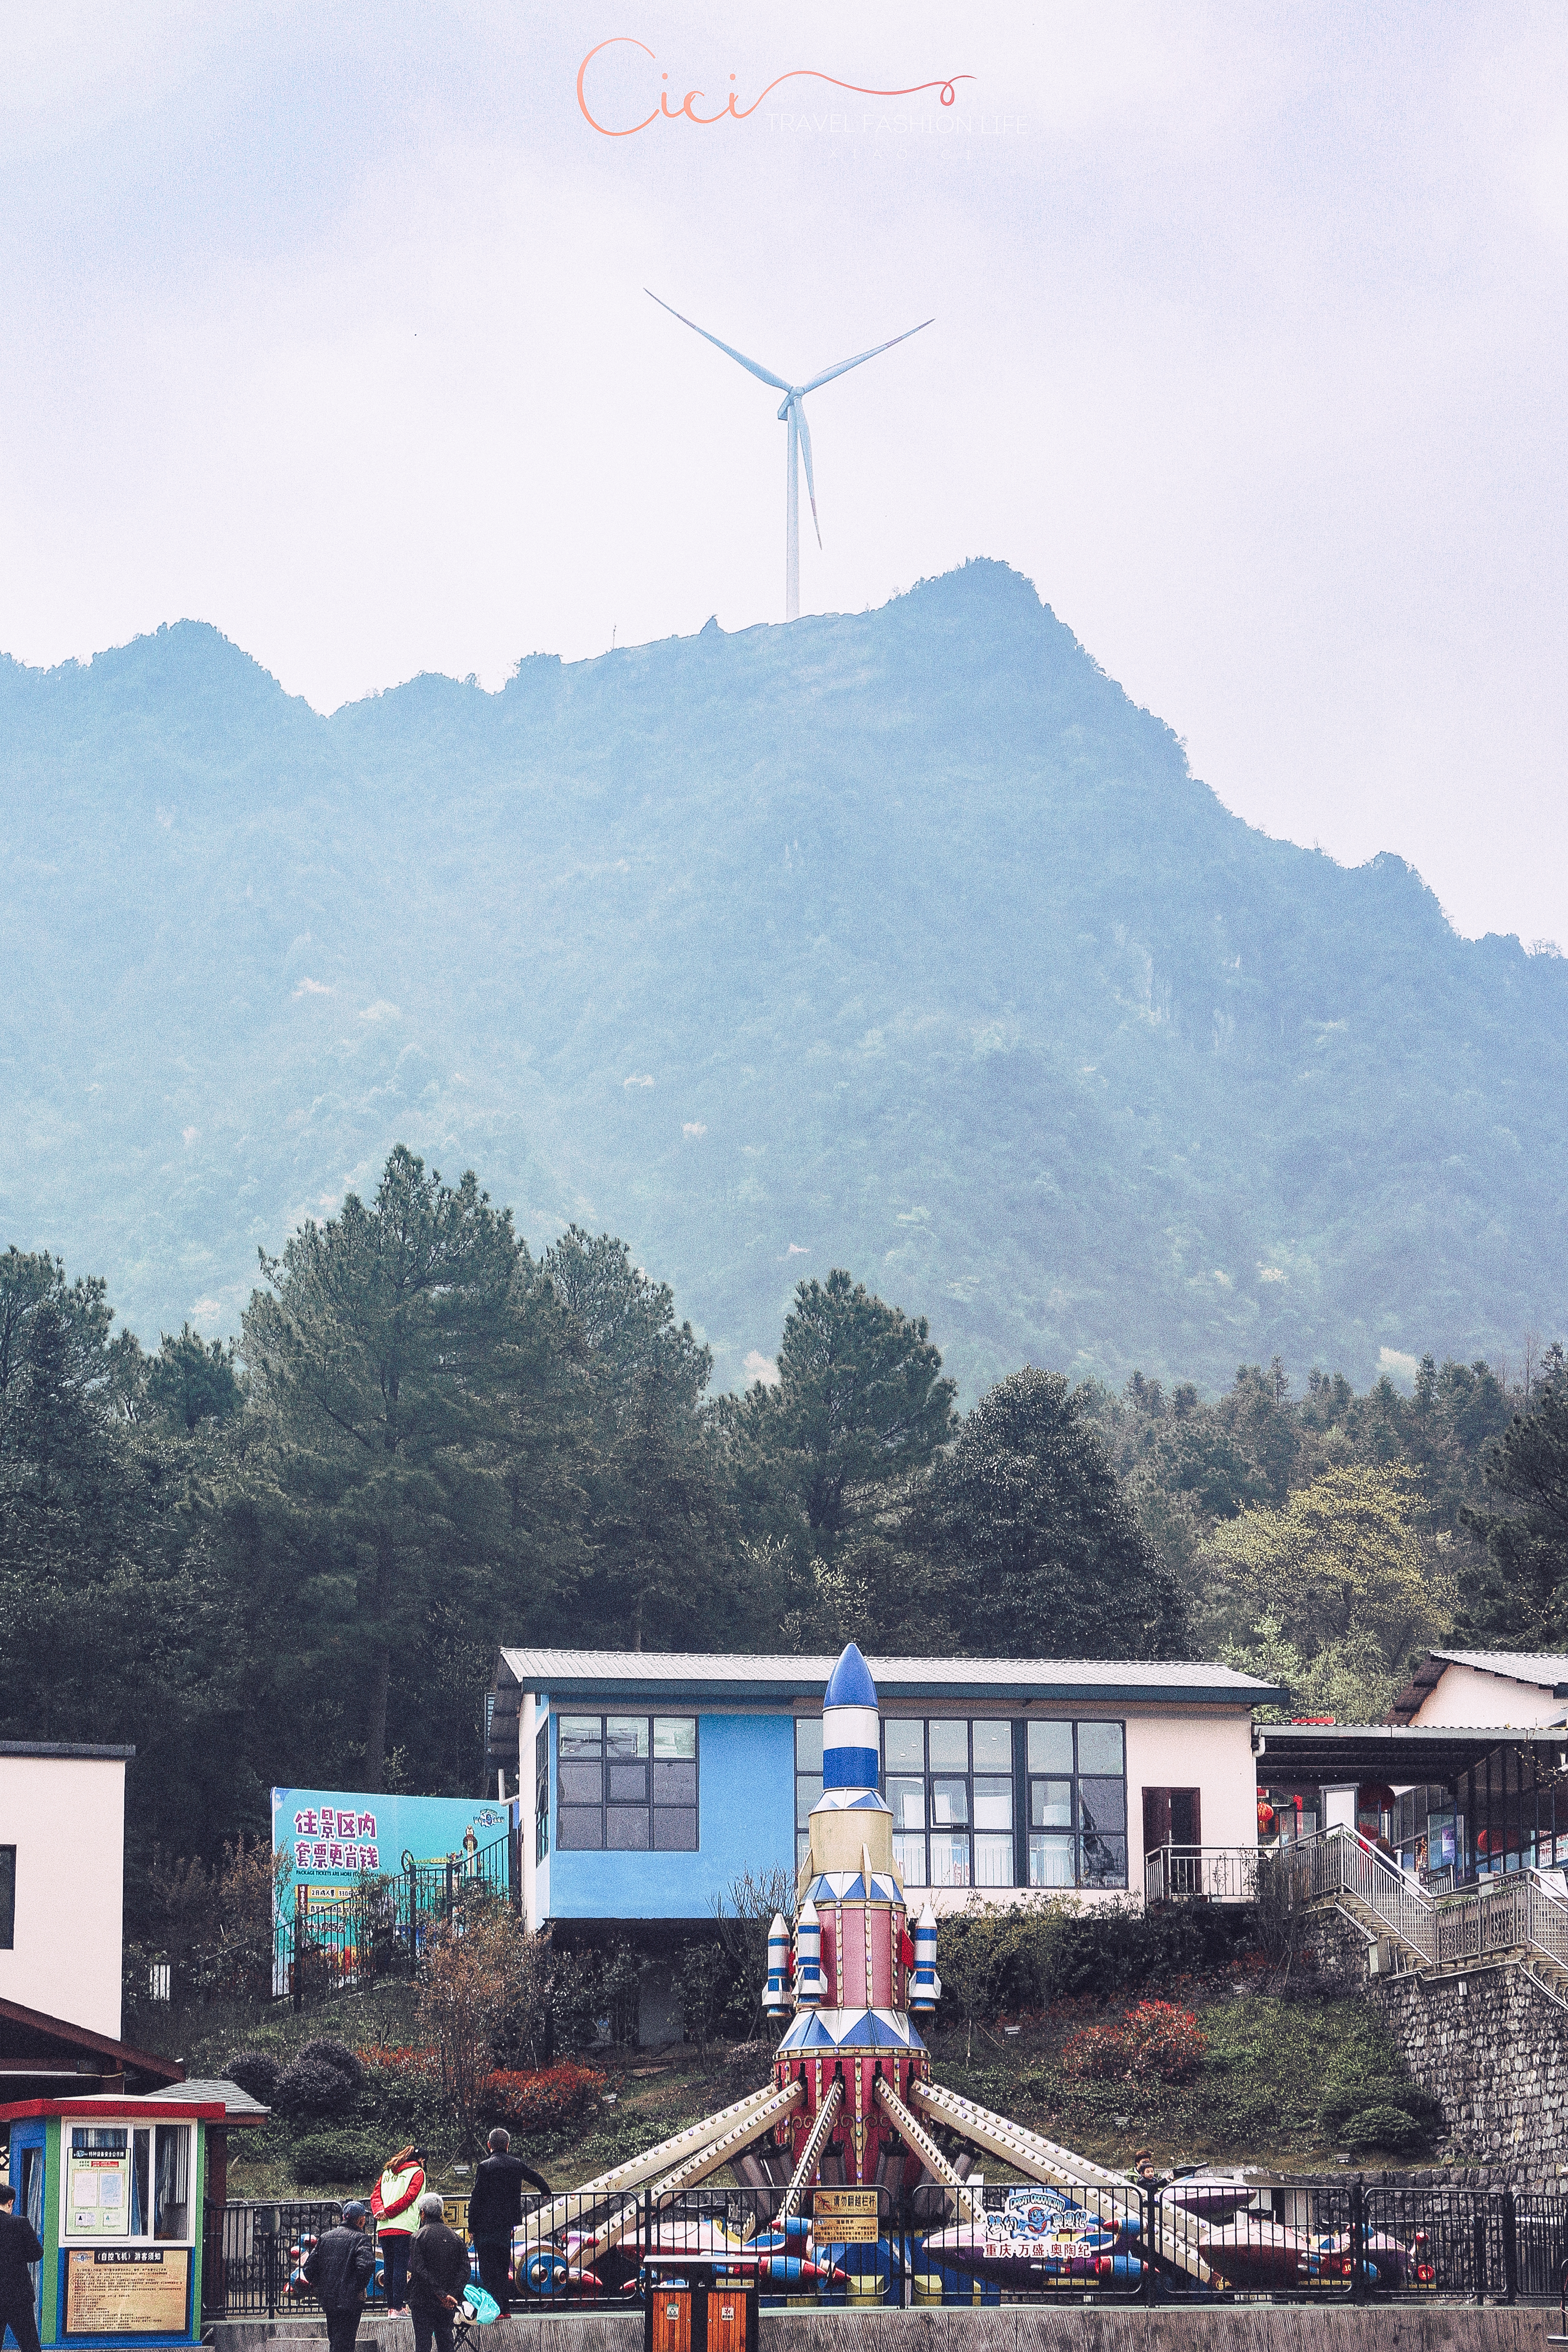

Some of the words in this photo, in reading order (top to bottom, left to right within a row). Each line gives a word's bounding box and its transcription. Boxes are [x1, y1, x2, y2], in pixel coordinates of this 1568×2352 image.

[295, 1808, 376, 1839] 住景区内
[295, 1841, 379, 1868] 套票更省钱
[834, 2195, 875, 2207] 请勿翻越栏杆
[1009, 2195, 1030, 2211] DREAM
[1030, 2193, 1065, 2213] ORDOVICIAN
[987, 2214, 1018, 2235] 梦幻
[1051, 2211, 1087, 2229] 奥陶纪
[985, 2243, 1090, 2257] 重庆·万盛·奥陶纪
